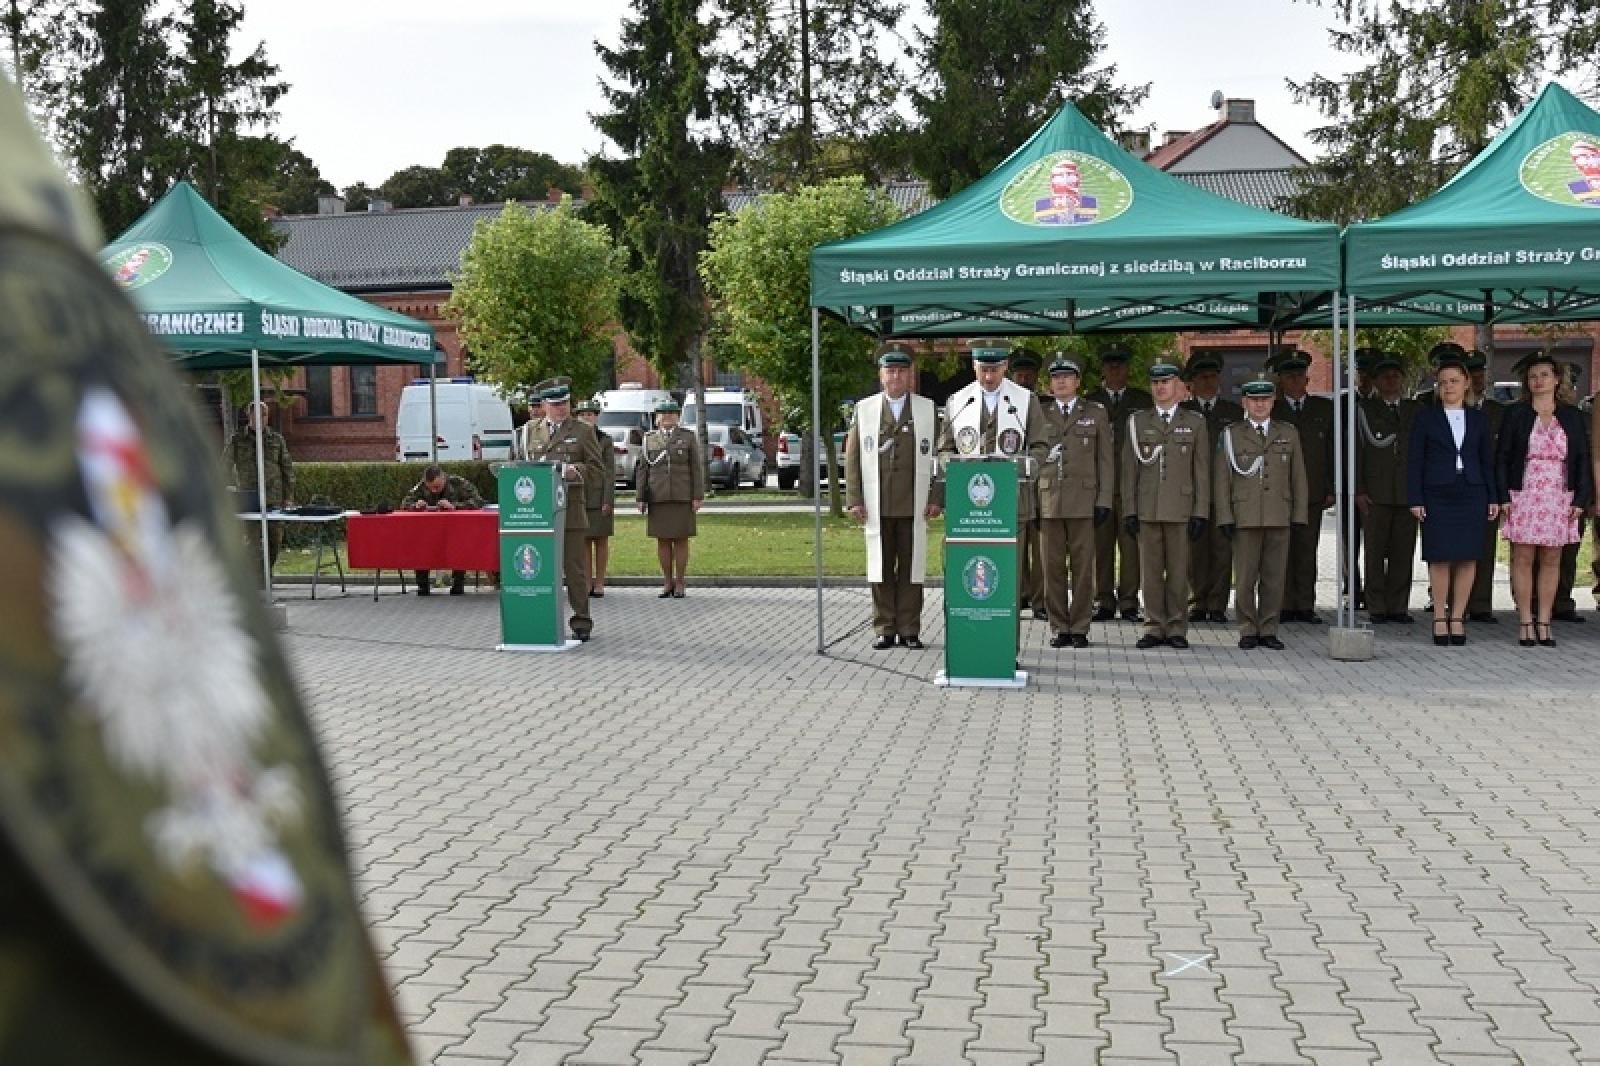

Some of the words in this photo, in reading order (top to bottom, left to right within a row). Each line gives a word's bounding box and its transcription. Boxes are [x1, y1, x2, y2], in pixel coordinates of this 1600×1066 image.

[839, 267, 889, 286] Śląski
[893, 267, 954, 281] Oddział
[959, 264, 1011, 281] Straży
[1015, 261, 1105, 277] Granicznej
[1109, 262, 1119, 275] z
[1123, 259, 1195, 275] siedzibą
[1199, 260, 1215, 271] w
[1219, 256, 1307, 271] Raciborzu
[1381, 253, 1436, 272] Śląski
[1441, 251, 1511, 267] Oddział
[1515, 248, 1575, 265] Straży
[143, 312, 244, 335] RANICZNEJ
